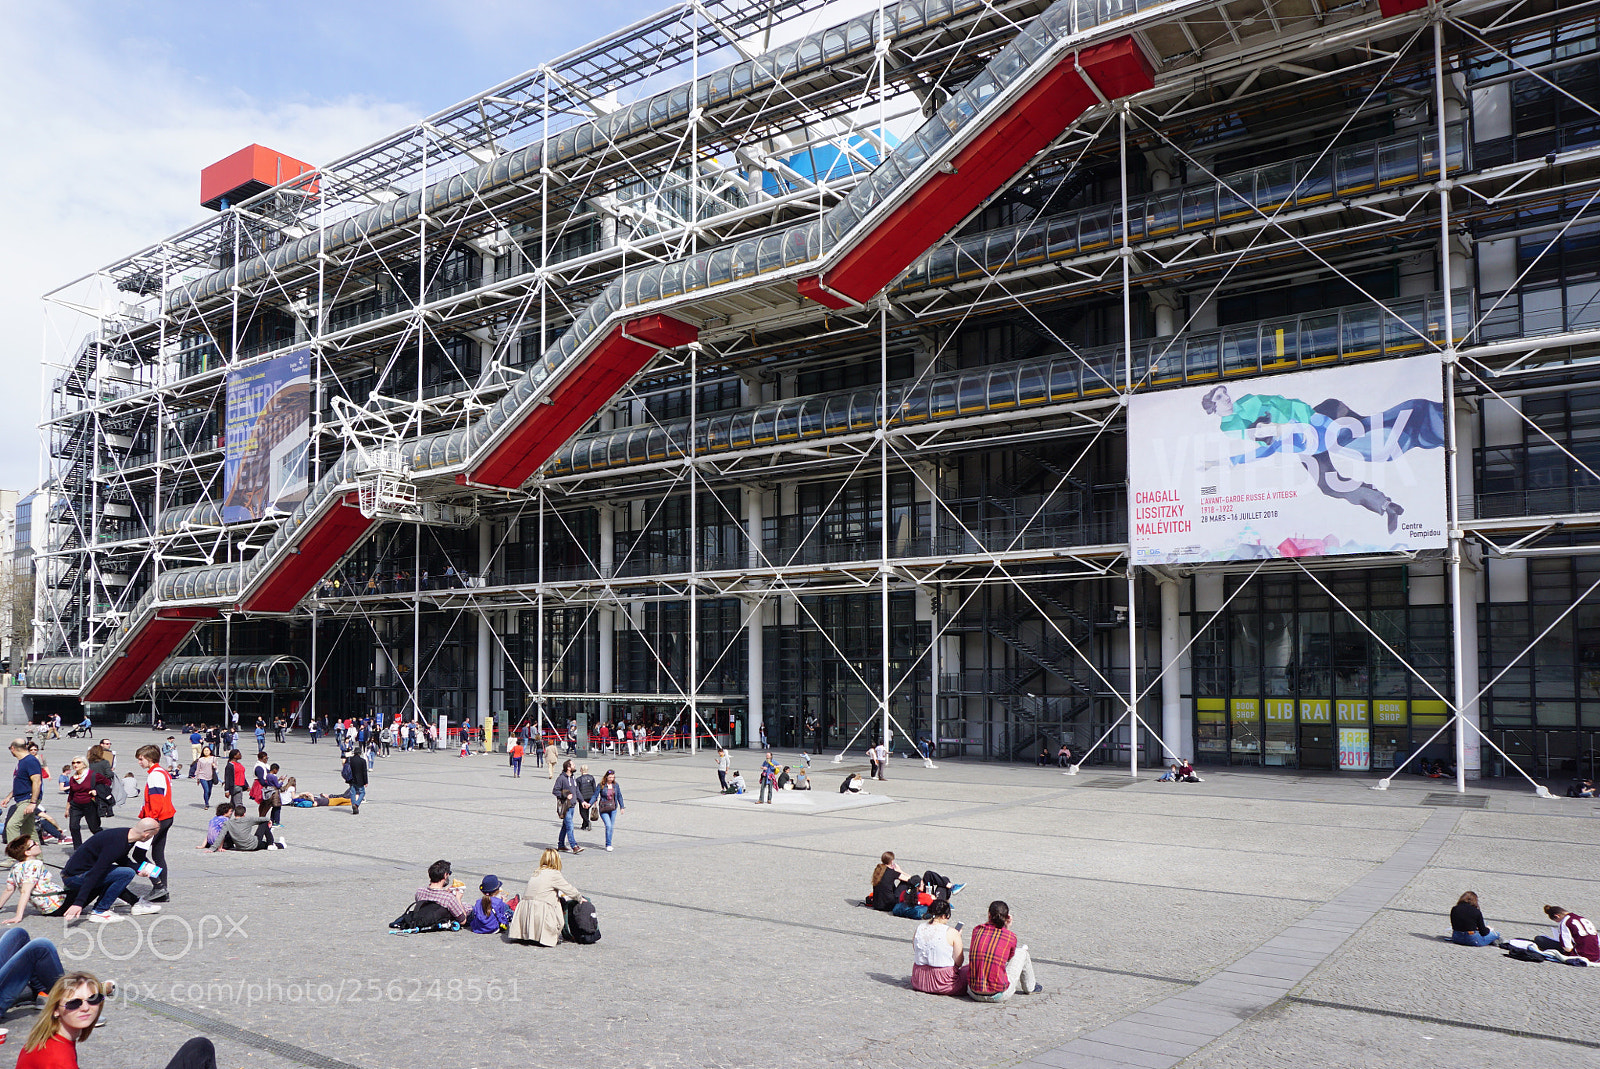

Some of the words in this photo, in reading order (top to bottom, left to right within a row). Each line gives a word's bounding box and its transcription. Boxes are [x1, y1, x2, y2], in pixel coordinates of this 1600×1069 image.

[1136, 489, 1180, 504] CHAGALL
[1246, 493, 1265, 502] RUSSE
[1272, 490, 1298, 500] VITEBSK
[1136, 505, 1184, 520] LISSITZKY
[1210, 514, 1226, 522] MARS
[1239, 511, 1262, 520] JUILLET
[1264, 510, 1278, 519] 2018
[1136, 519, 1191, 535] MALÉVITCH
[1410, 530, 1441, 539] Pompidou
[1236, 702, 1254, 710] BOOK
[1379, 703, 1400, 712] BOOK
[1379, 713, 1400, 721] SHOP
[1340, 751, 1370, 766] 2017
